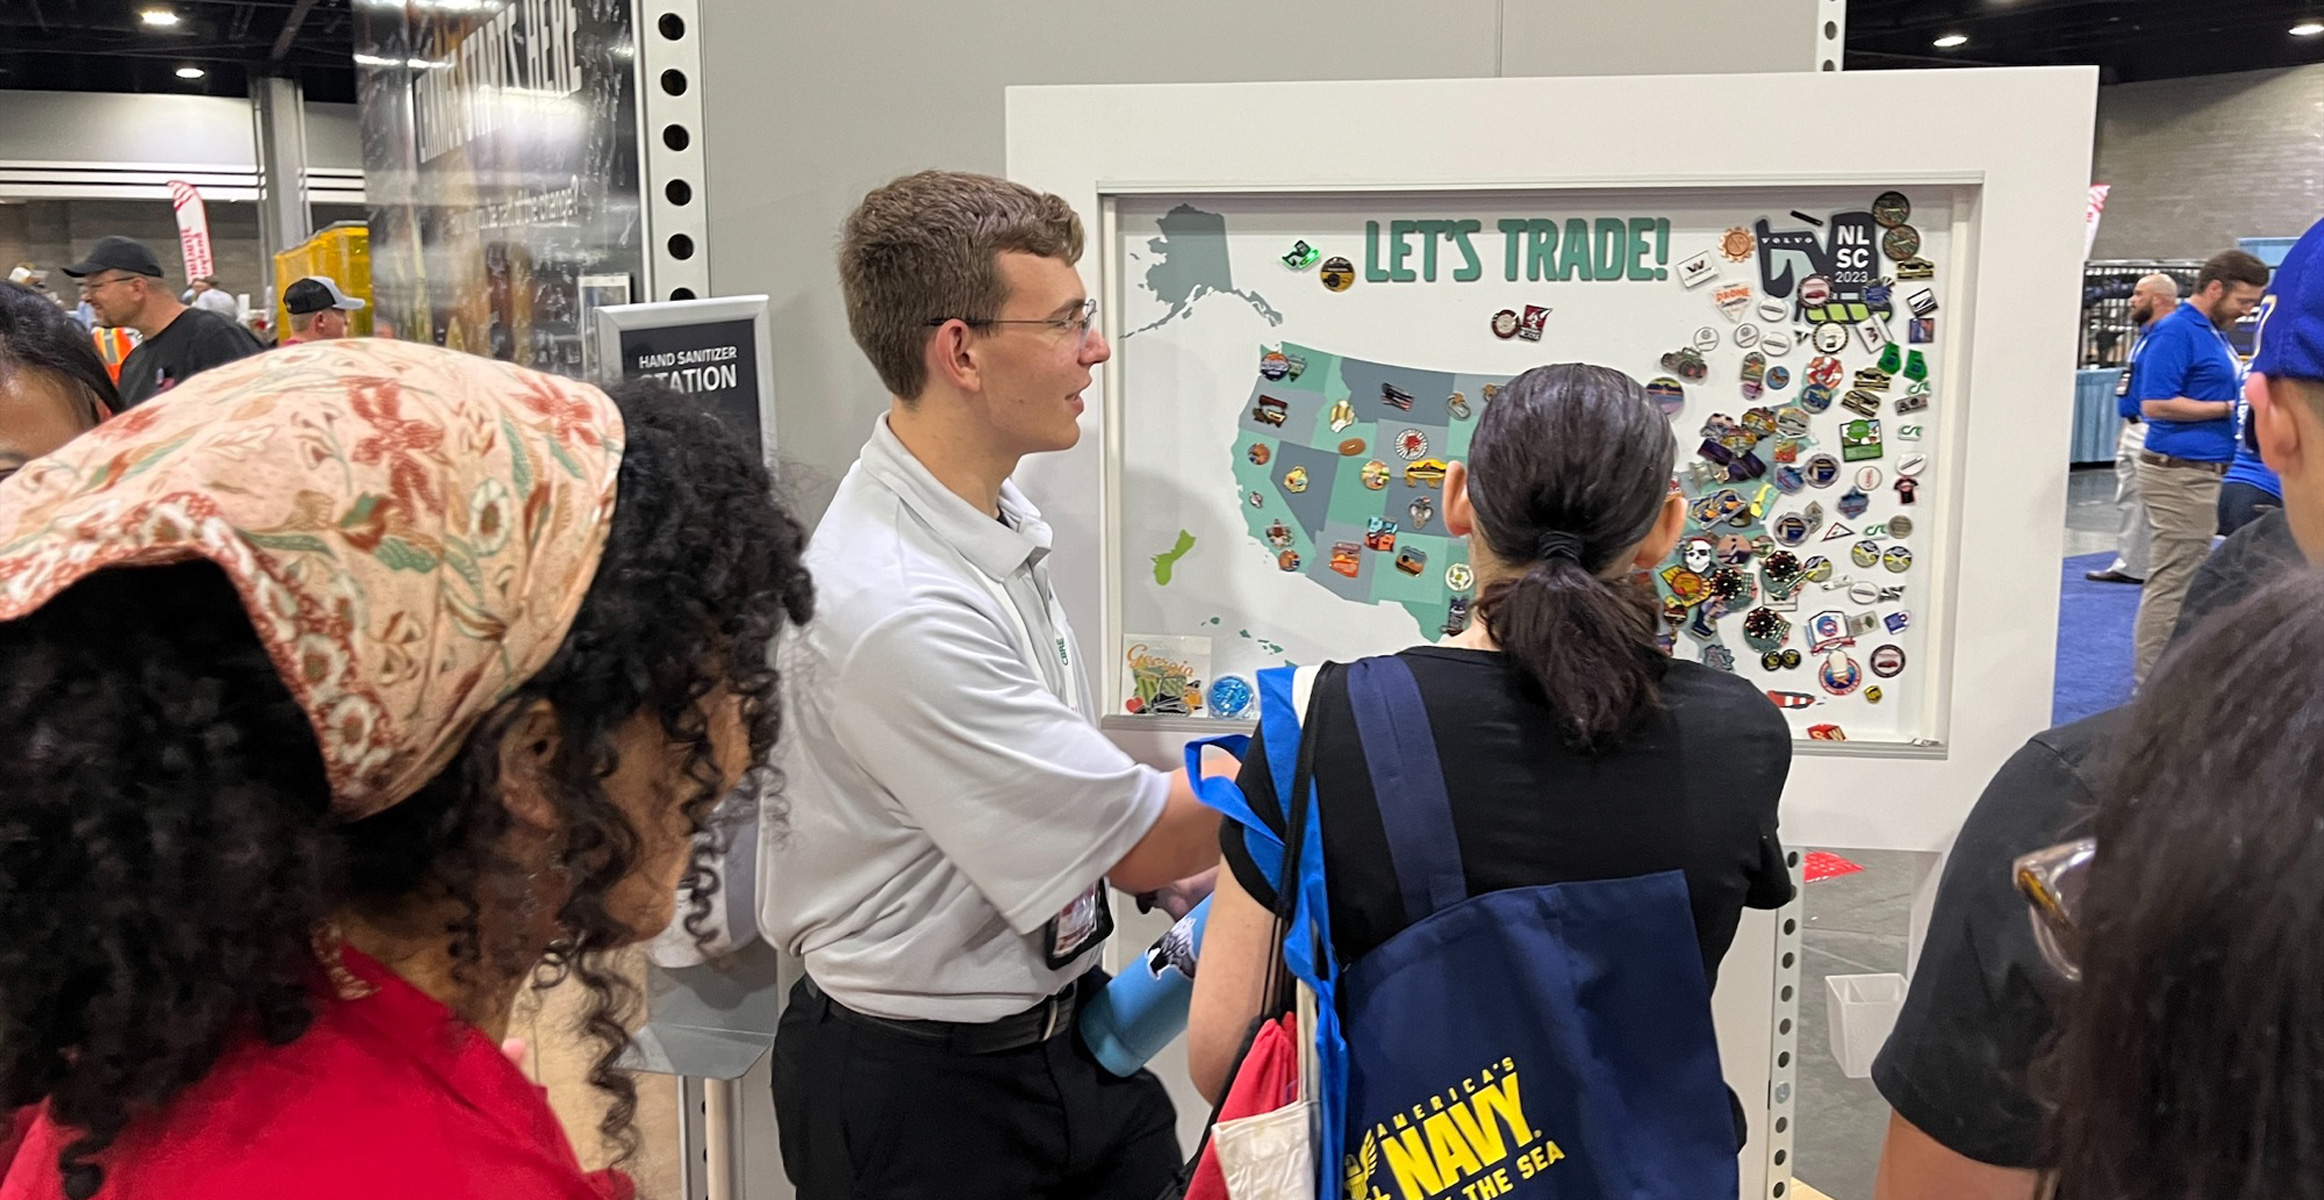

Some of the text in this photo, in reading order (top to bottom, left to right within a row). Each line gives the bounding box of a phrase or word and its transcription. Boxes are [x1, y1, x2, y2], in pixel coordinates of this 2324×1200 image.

[523, 0, 582, 95] HERE
[1366, 217, 1670, 281] LET'S TRADE!
[1837, 225, 1870, 245] NL
[1836, 248, 1869, 268] SC
[1835, 271, 1868, 283] 2023
[639, 346, 737, 368] HAND SANITIZER
[640, 363, 737, 394] ATION
[1127, 644, 1195, 677] Georgia
[1377, 1056, 1515, 1138] AMERICA'S
[1462, 1140, 1565, 1200] THE SEA
